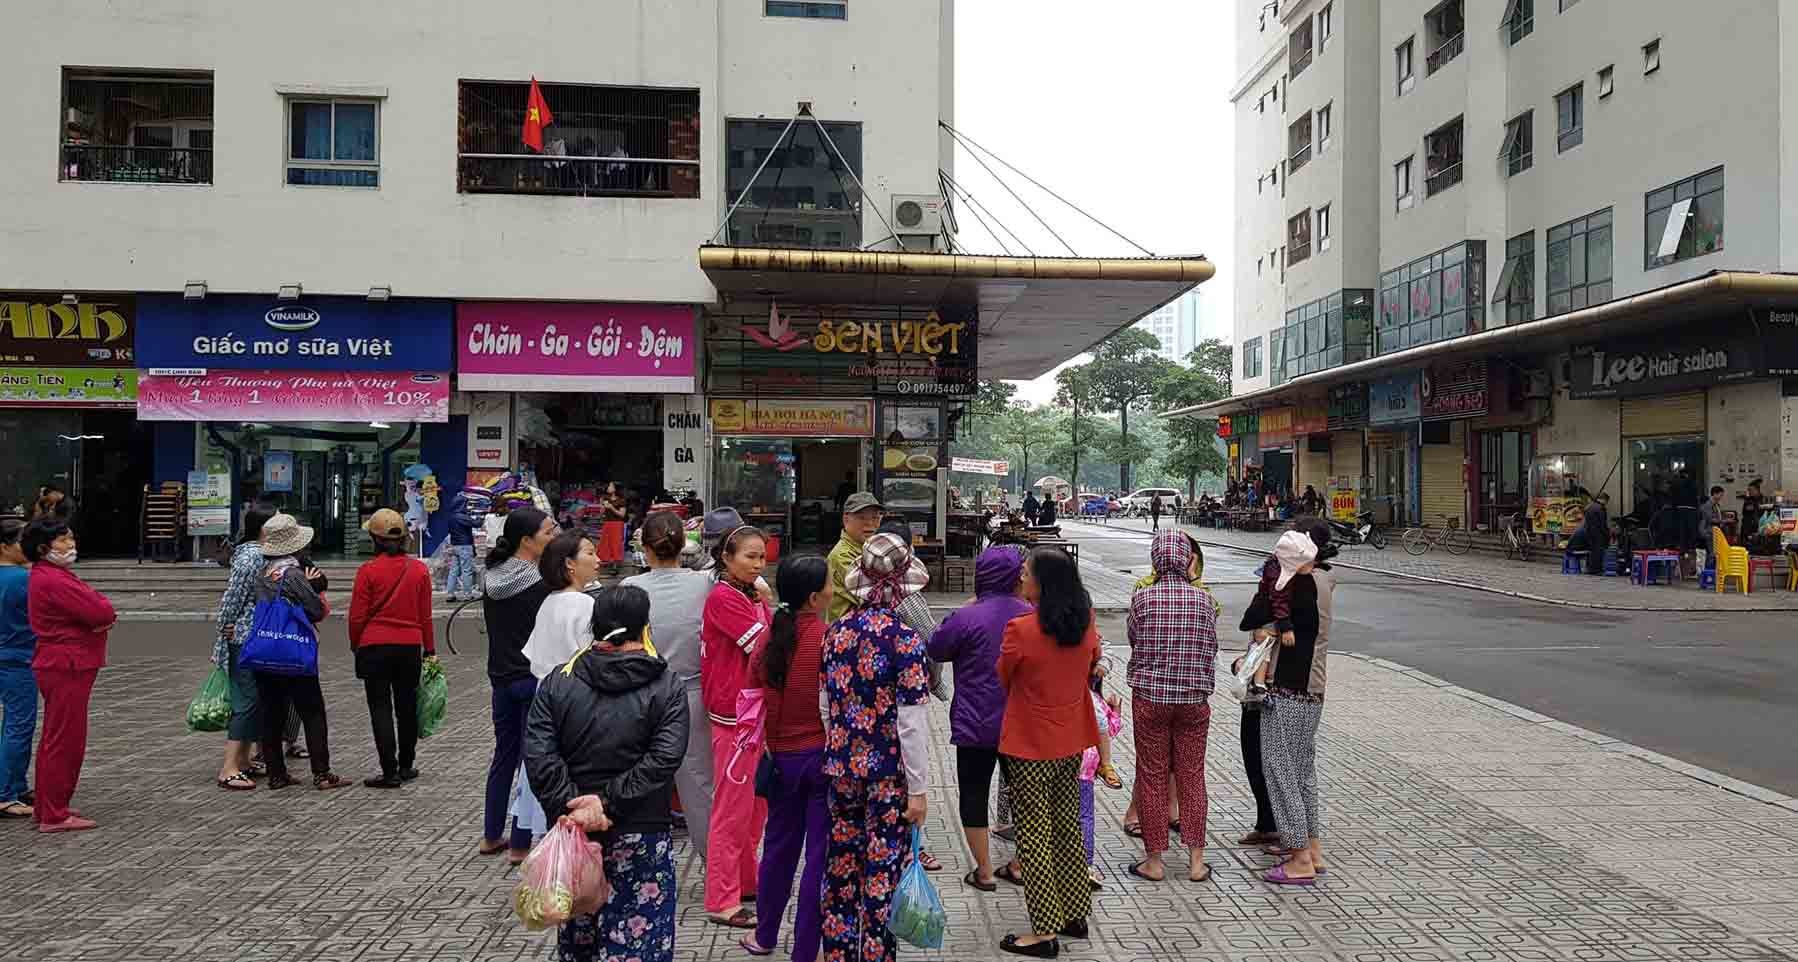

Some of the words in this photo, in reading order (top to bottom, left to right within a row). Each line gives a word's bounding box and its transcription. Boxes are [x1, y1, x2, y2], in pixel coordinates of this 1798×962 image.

[270, 310, 315, 321] VINAMILK
[193, 332, 246, 354] Giấc
[253, 338, 290, 354] mơ
[297, 337, 339, 355] sữa
[347, 338, 392, 360] Việt
[468, 323, 522, 356] Chăn
[540, 324, 569, 356] Ga
[587, 318, 622, 357] Gối
[638, 325, 683, 368] Đệm
[1592, 351, 1647, 387] Lee
[1649, 352, 1680, 377] Hair
[1682, 347, 1728, 373] salon
[190, 389, 204, 403] 1
[248, 389, 264, 404] 1
[383, 391, 432, 406] 10%
[674, 448, 695, 463] GA
